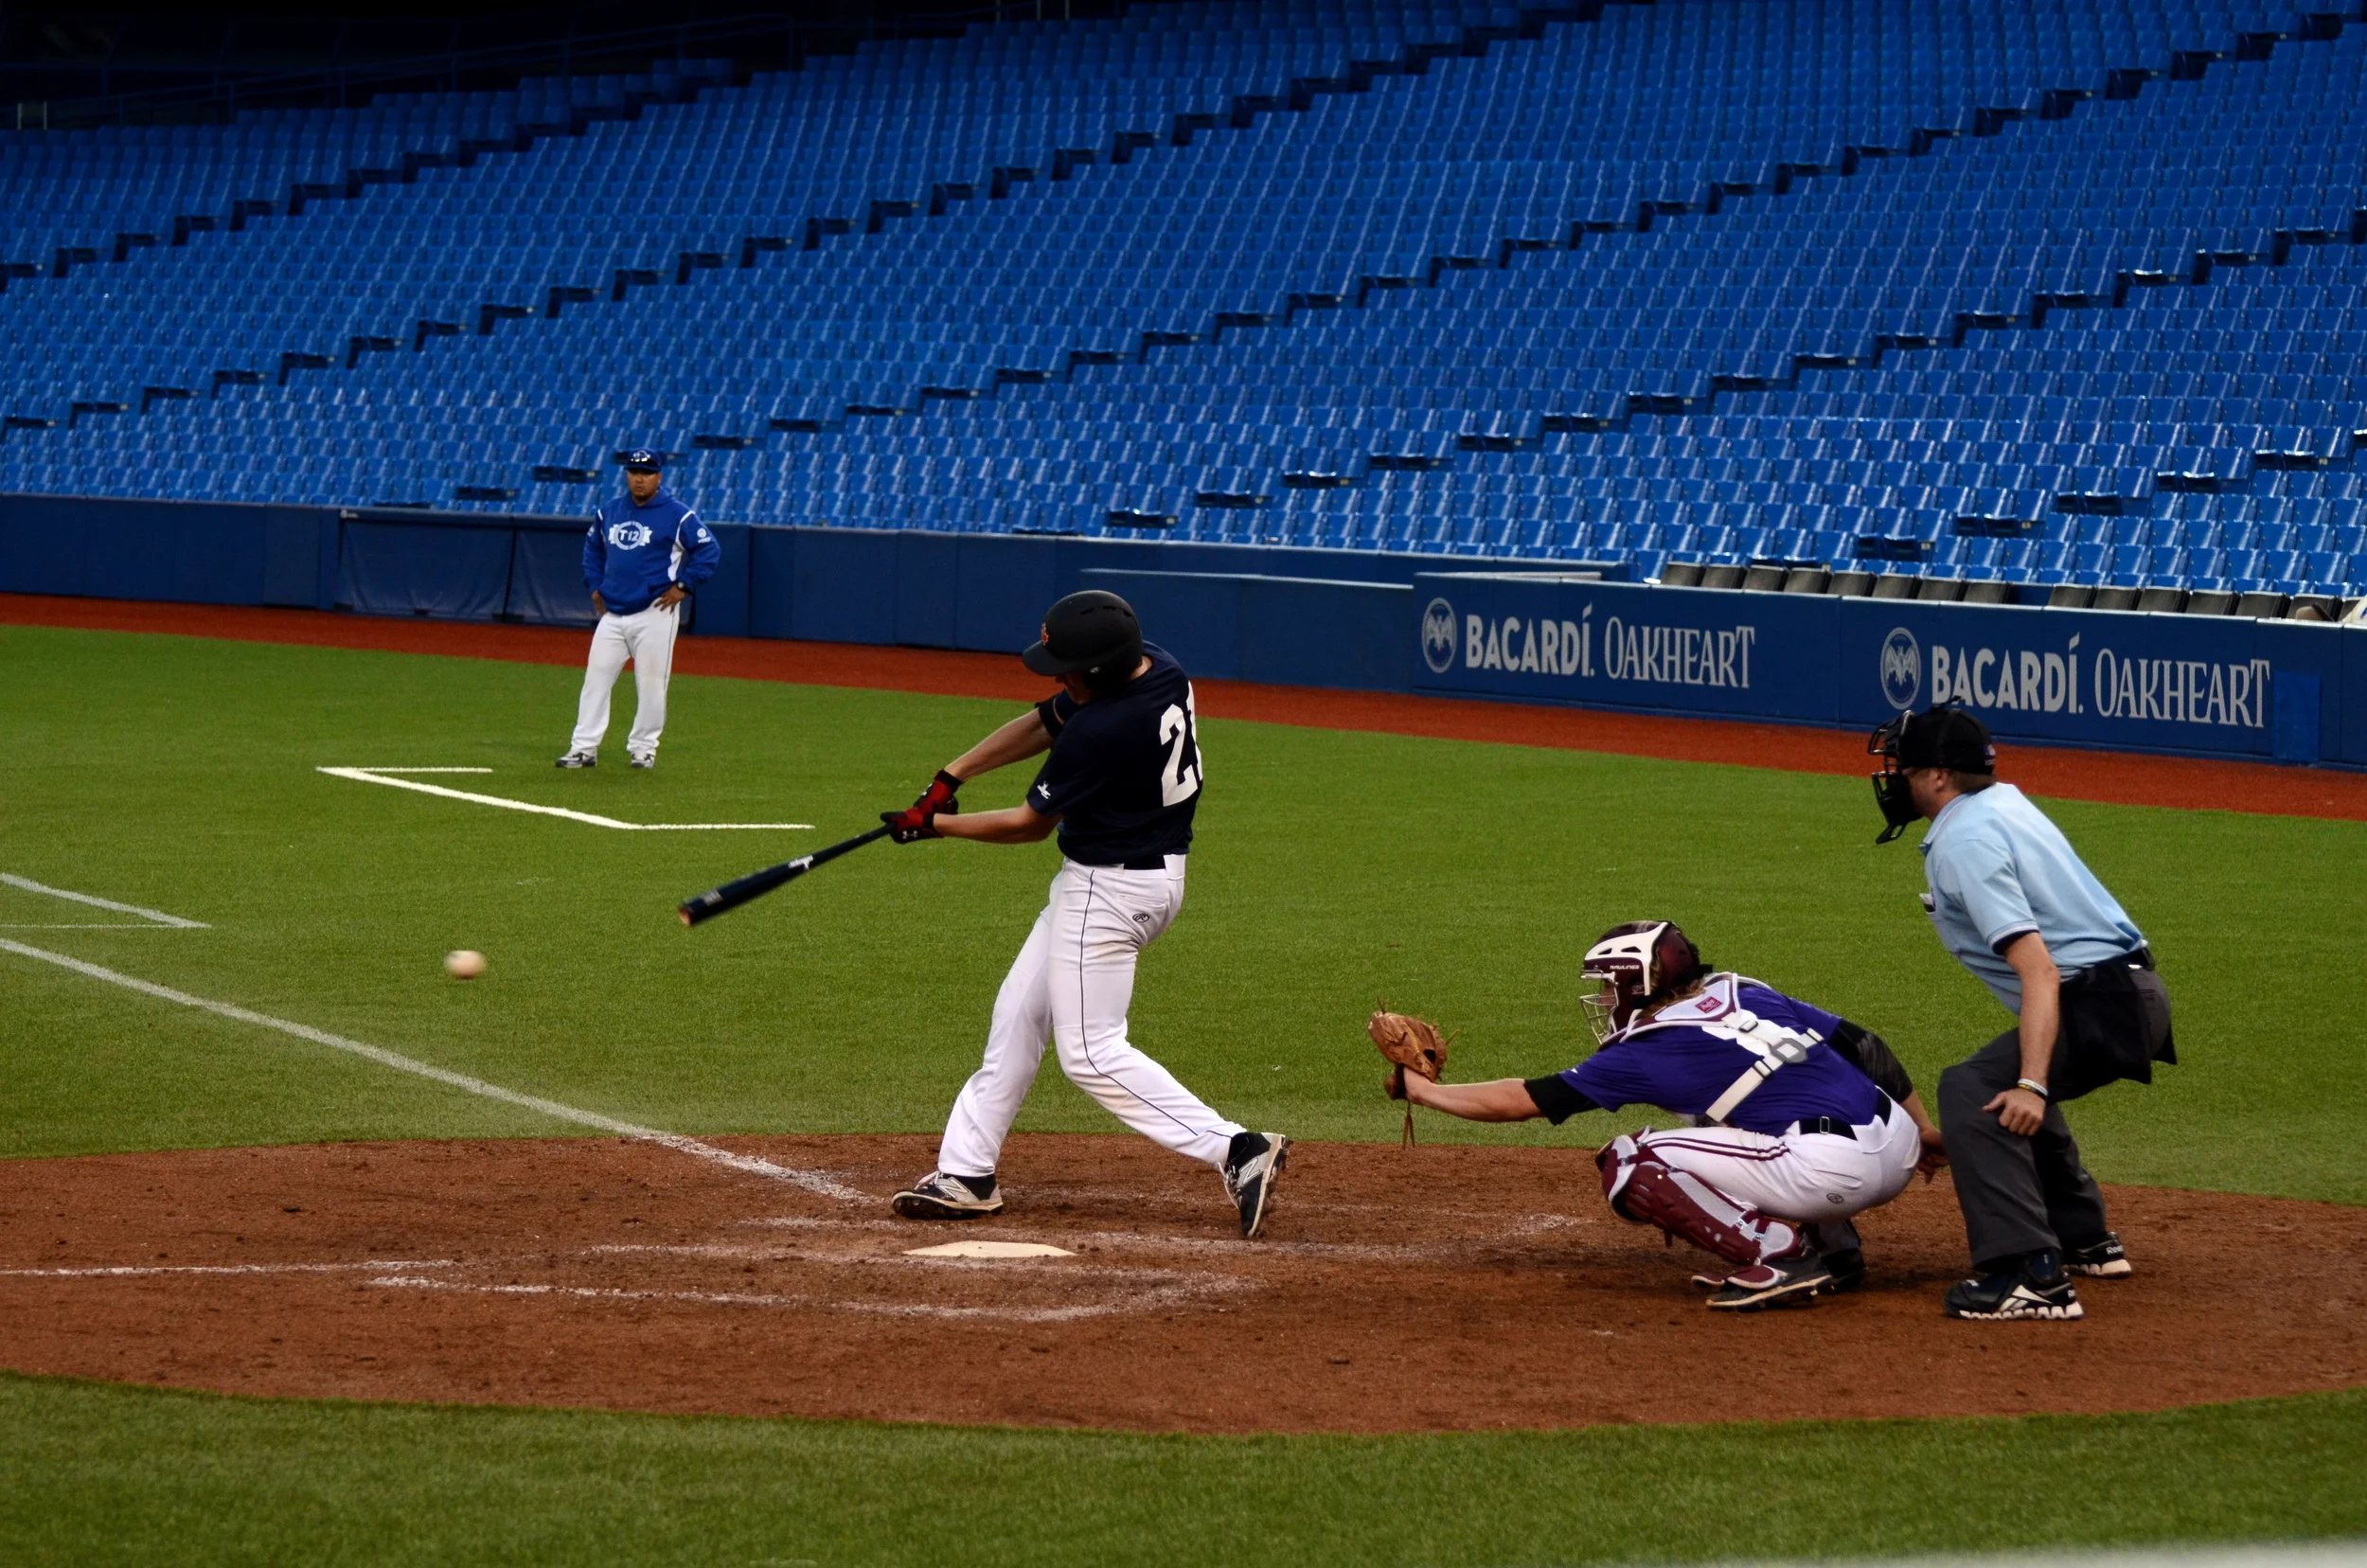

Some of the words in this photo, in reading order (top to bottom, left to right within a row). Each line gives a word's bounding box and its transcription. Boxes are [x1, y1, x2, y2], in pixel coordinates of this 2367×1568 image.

[619, 529, 640, 542] T12
[1604, 615, 1755, 689] OAKHEART
[2094, 648, 2270, 728] OAKHEART
